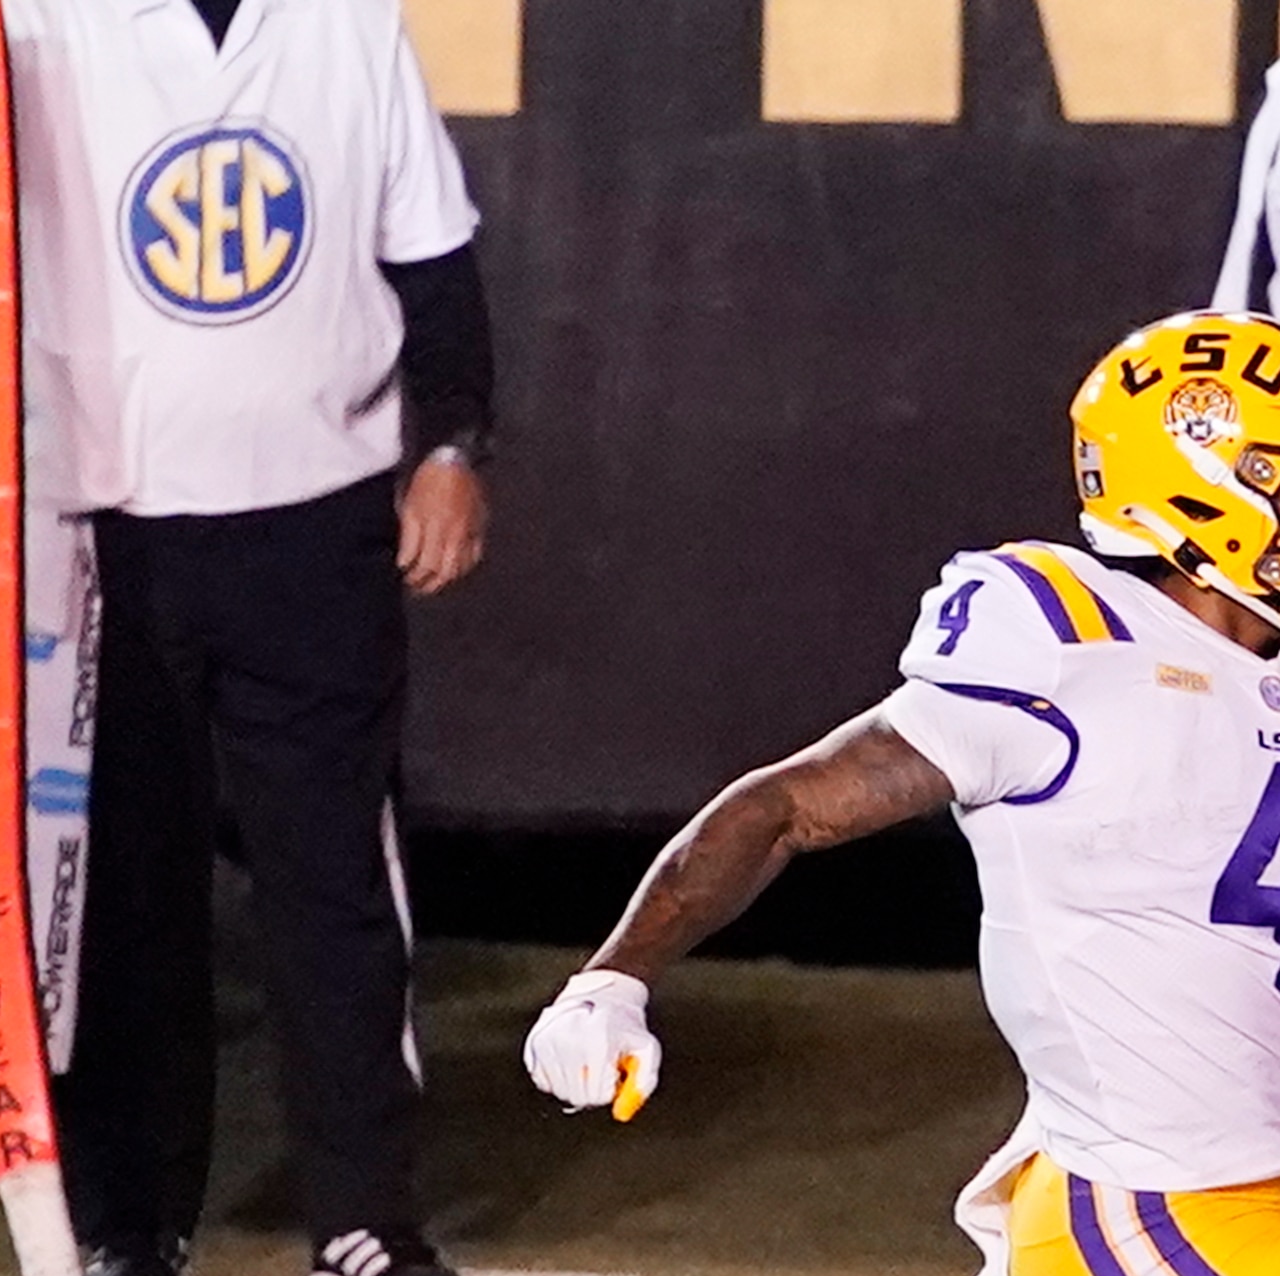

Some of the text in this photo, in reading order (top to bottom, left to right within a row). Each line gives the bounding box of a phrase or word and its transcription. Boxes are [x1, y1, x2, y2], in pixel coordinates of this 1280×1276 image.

[144, 138, 294, 304] SEC
[935, 579, 985, 656] 4
[39, 838, 80, 1040] OWERADE
